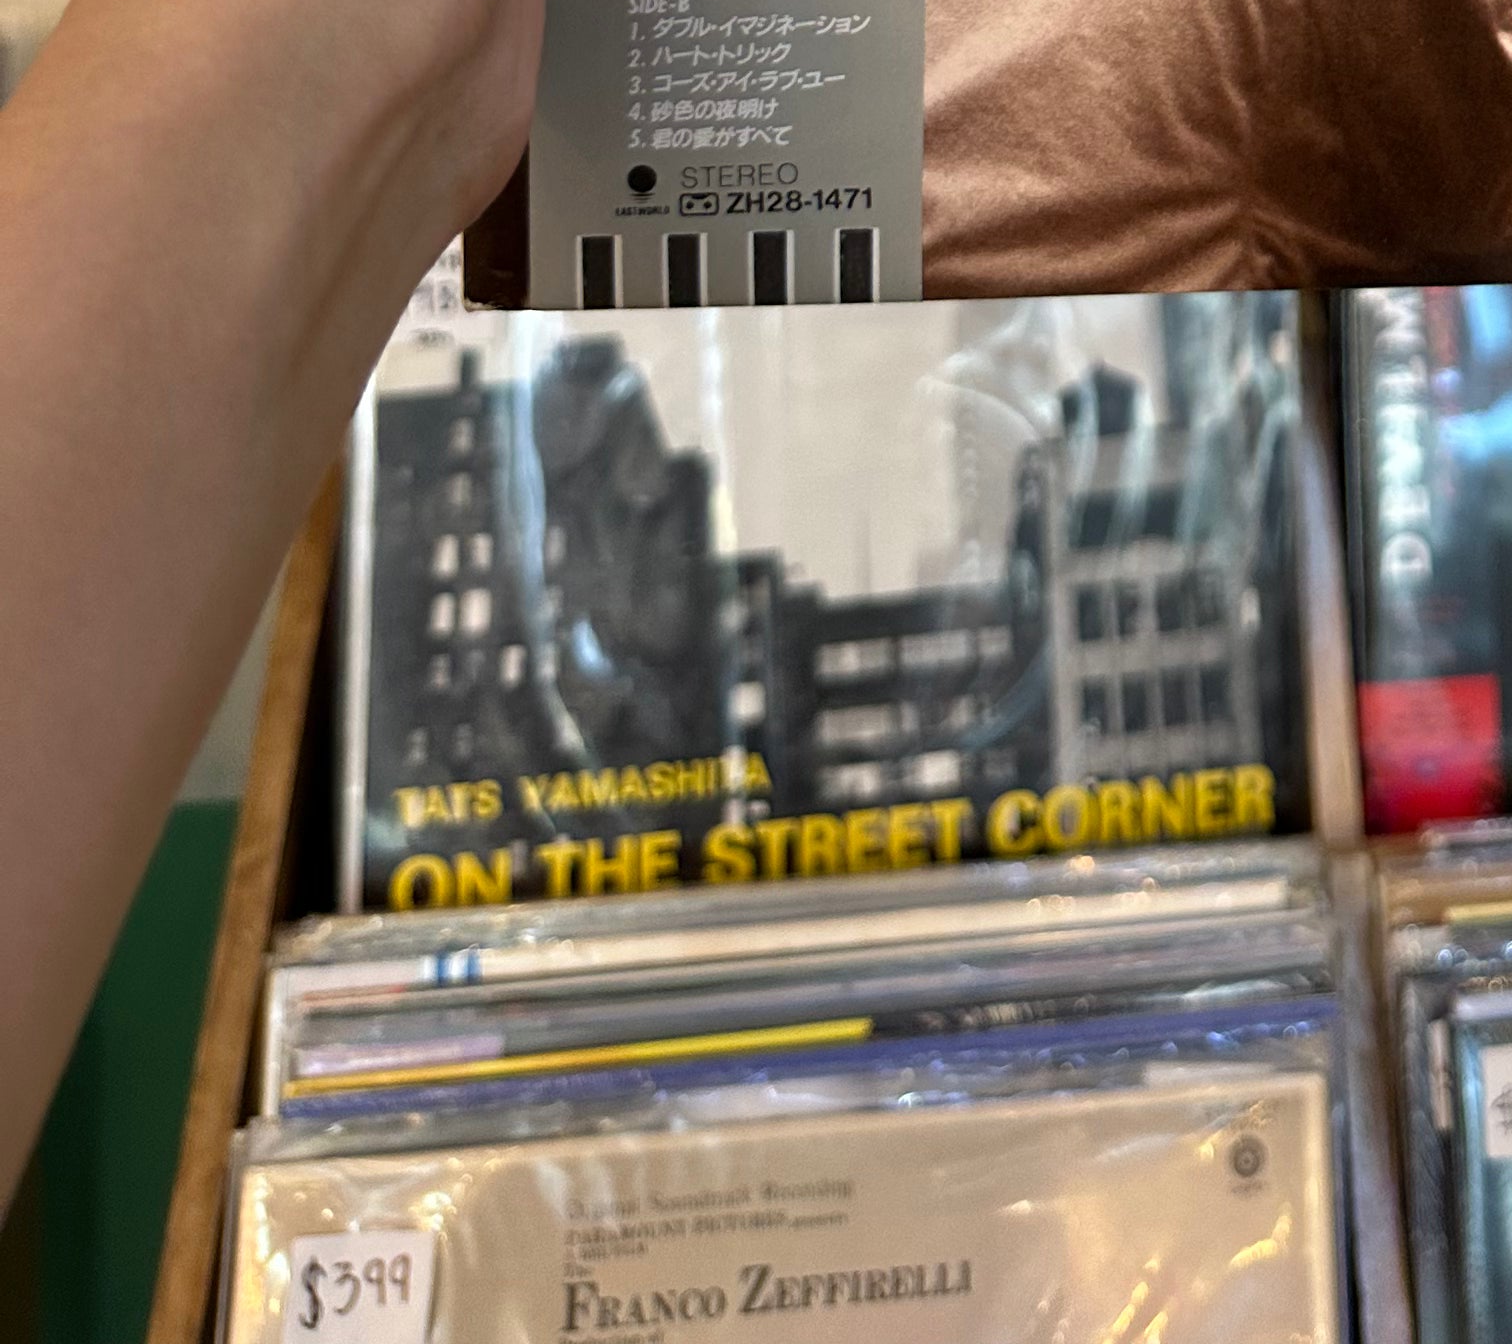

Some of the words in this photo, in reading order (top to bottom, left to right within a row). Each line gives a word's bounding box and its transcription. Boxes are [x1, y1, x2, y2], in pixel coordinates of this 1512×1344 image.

[653, 14, 872, 39] ダブル・イマジネーション
[652, 42, 792, 67] ハート・トリック
[652, 125, 793, 150] 君の愛がすべて
[681, 162, 799, 190] STEREO
[726, 186, 873, 216] ZH28-1471
[393, 779, 502, 829] TATS
[388, 847, 512, 911] ON
[534, 829, 682, 899] THE
[702, 797, 974, 884] STREET
[987, 764, 1275, 857] CORNER
[300, 1252, 412, 1330] $399
[560, 1280, 727, 1331] FRANCO
[737, 1259, 973, 1314] ZEFFIRELLI
